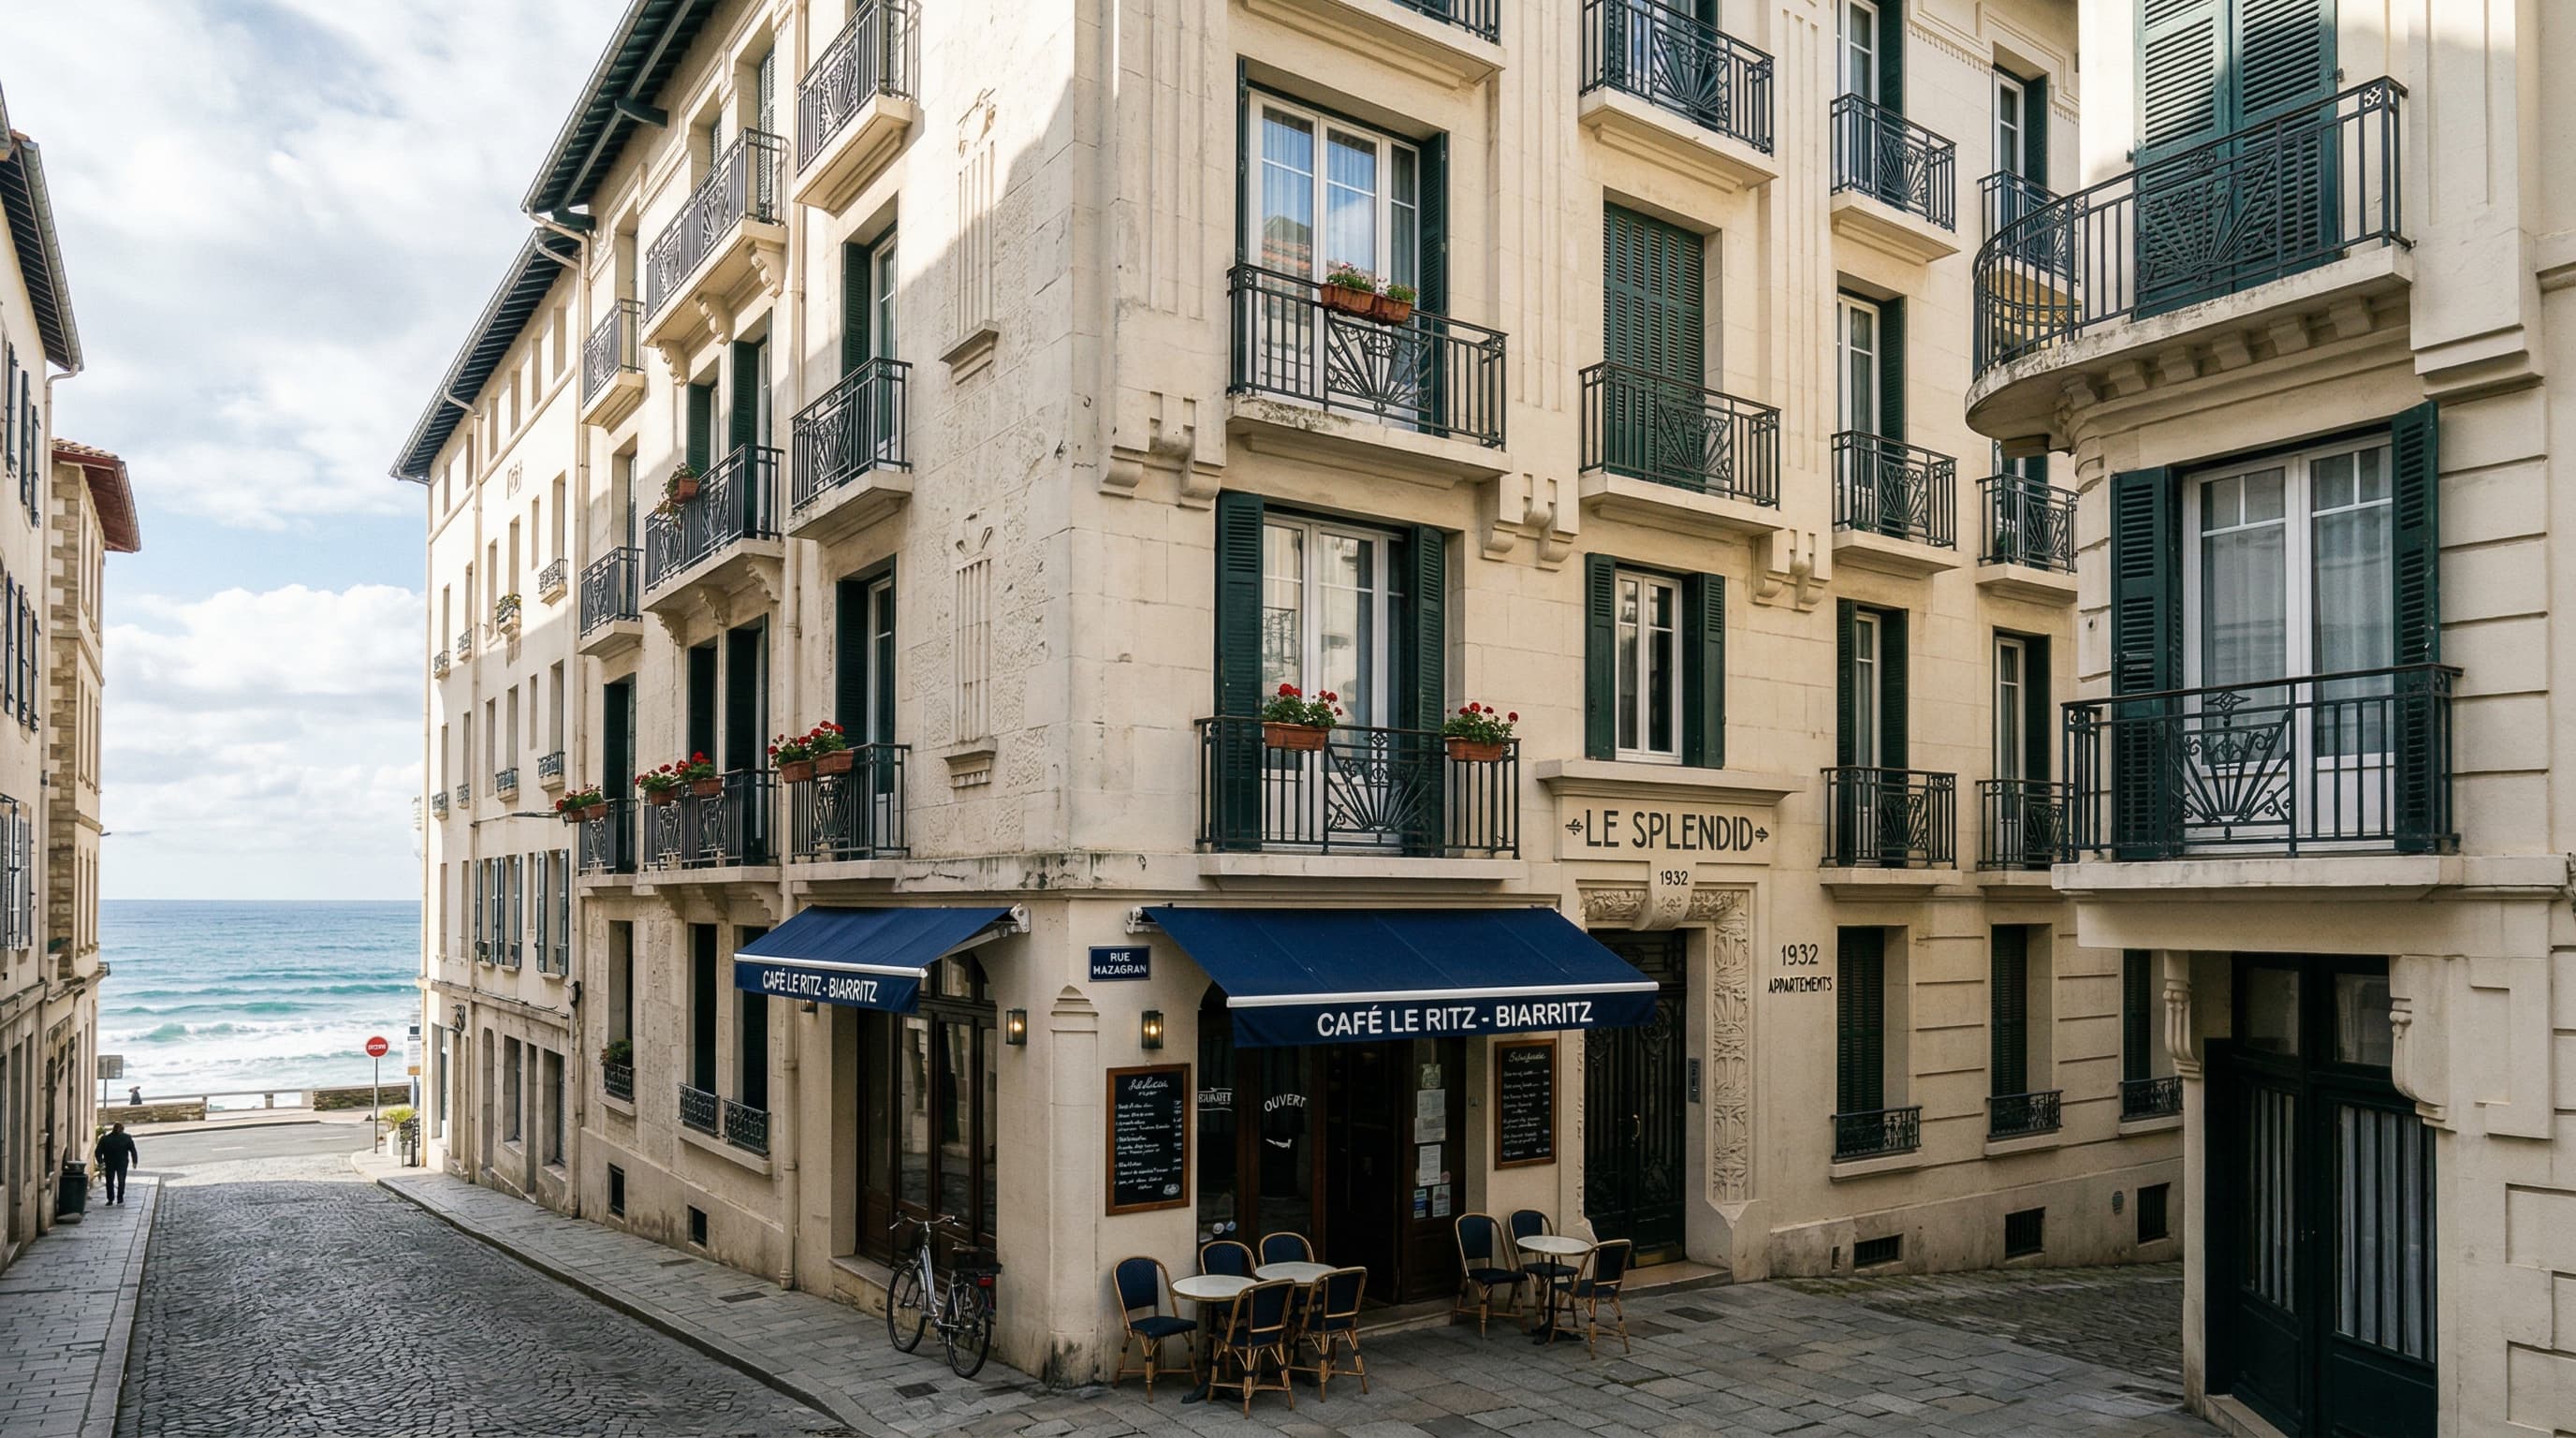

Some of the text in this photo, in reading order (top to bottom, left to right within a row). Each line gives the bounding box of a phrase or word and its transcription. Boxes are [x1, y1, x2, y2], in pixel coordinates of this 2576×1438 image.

[1586, 809, 1754, 851] LE SPLENDID
[1660, 870, 1689, 886] 1932
[1110, 952, 1131, 962] RUE
[1781, 944, 1819, 966] 1932
[763, 968, 785, 991] CAFÉ
[787, 973, 798, 993] LE
[800, 976, 822, 996] RITZ
[828, 977, 878, 1003] BIARRITZ
[1317, 1005, 1383, 1037] CAFÉ
[1390, 1008, 1419, 1033] LE
[1426, 1006, 1477, 1031] RITZ
[1496, 1001, 1594, 1028] BIARRITZ
[1264, 1093, 1308, 1112] OUVERT
